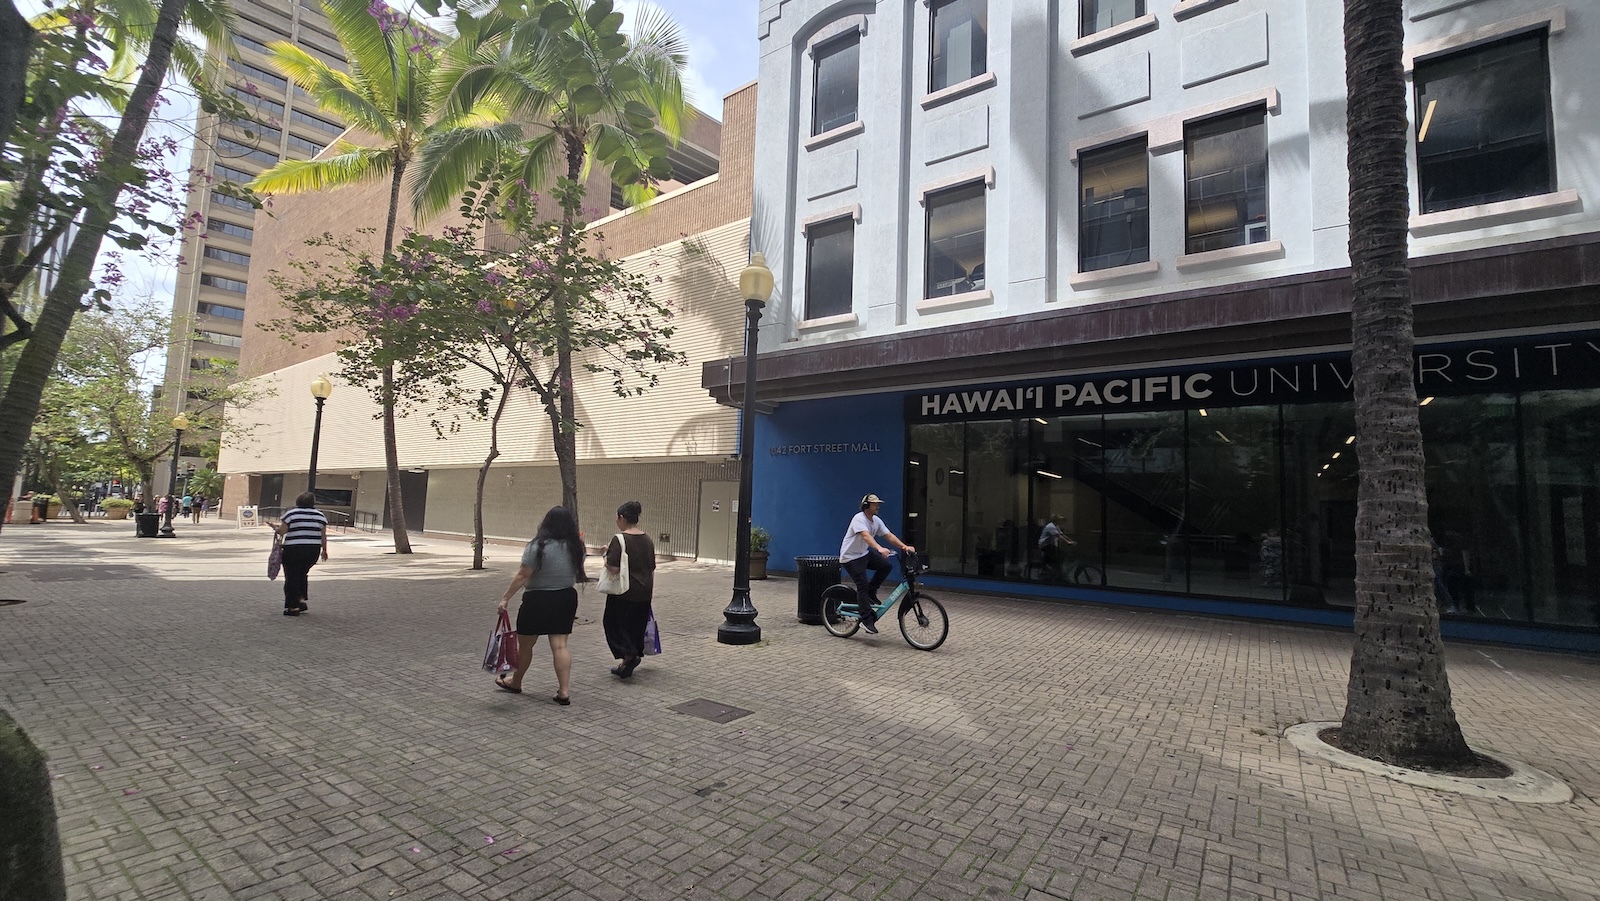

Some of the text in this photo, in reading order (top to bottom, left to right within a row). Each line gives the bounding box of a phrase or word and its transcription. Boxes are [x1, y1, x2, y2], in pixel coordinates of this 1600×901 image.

[1055, 373, 1213, 407] PACIFIC
[1230, 341, 1600, 397] UNIVRSIT
[788, 444, 812, 454] FORT
[813, 443, 849, 453] STREET
[851, 442, 880, 452] MALL
